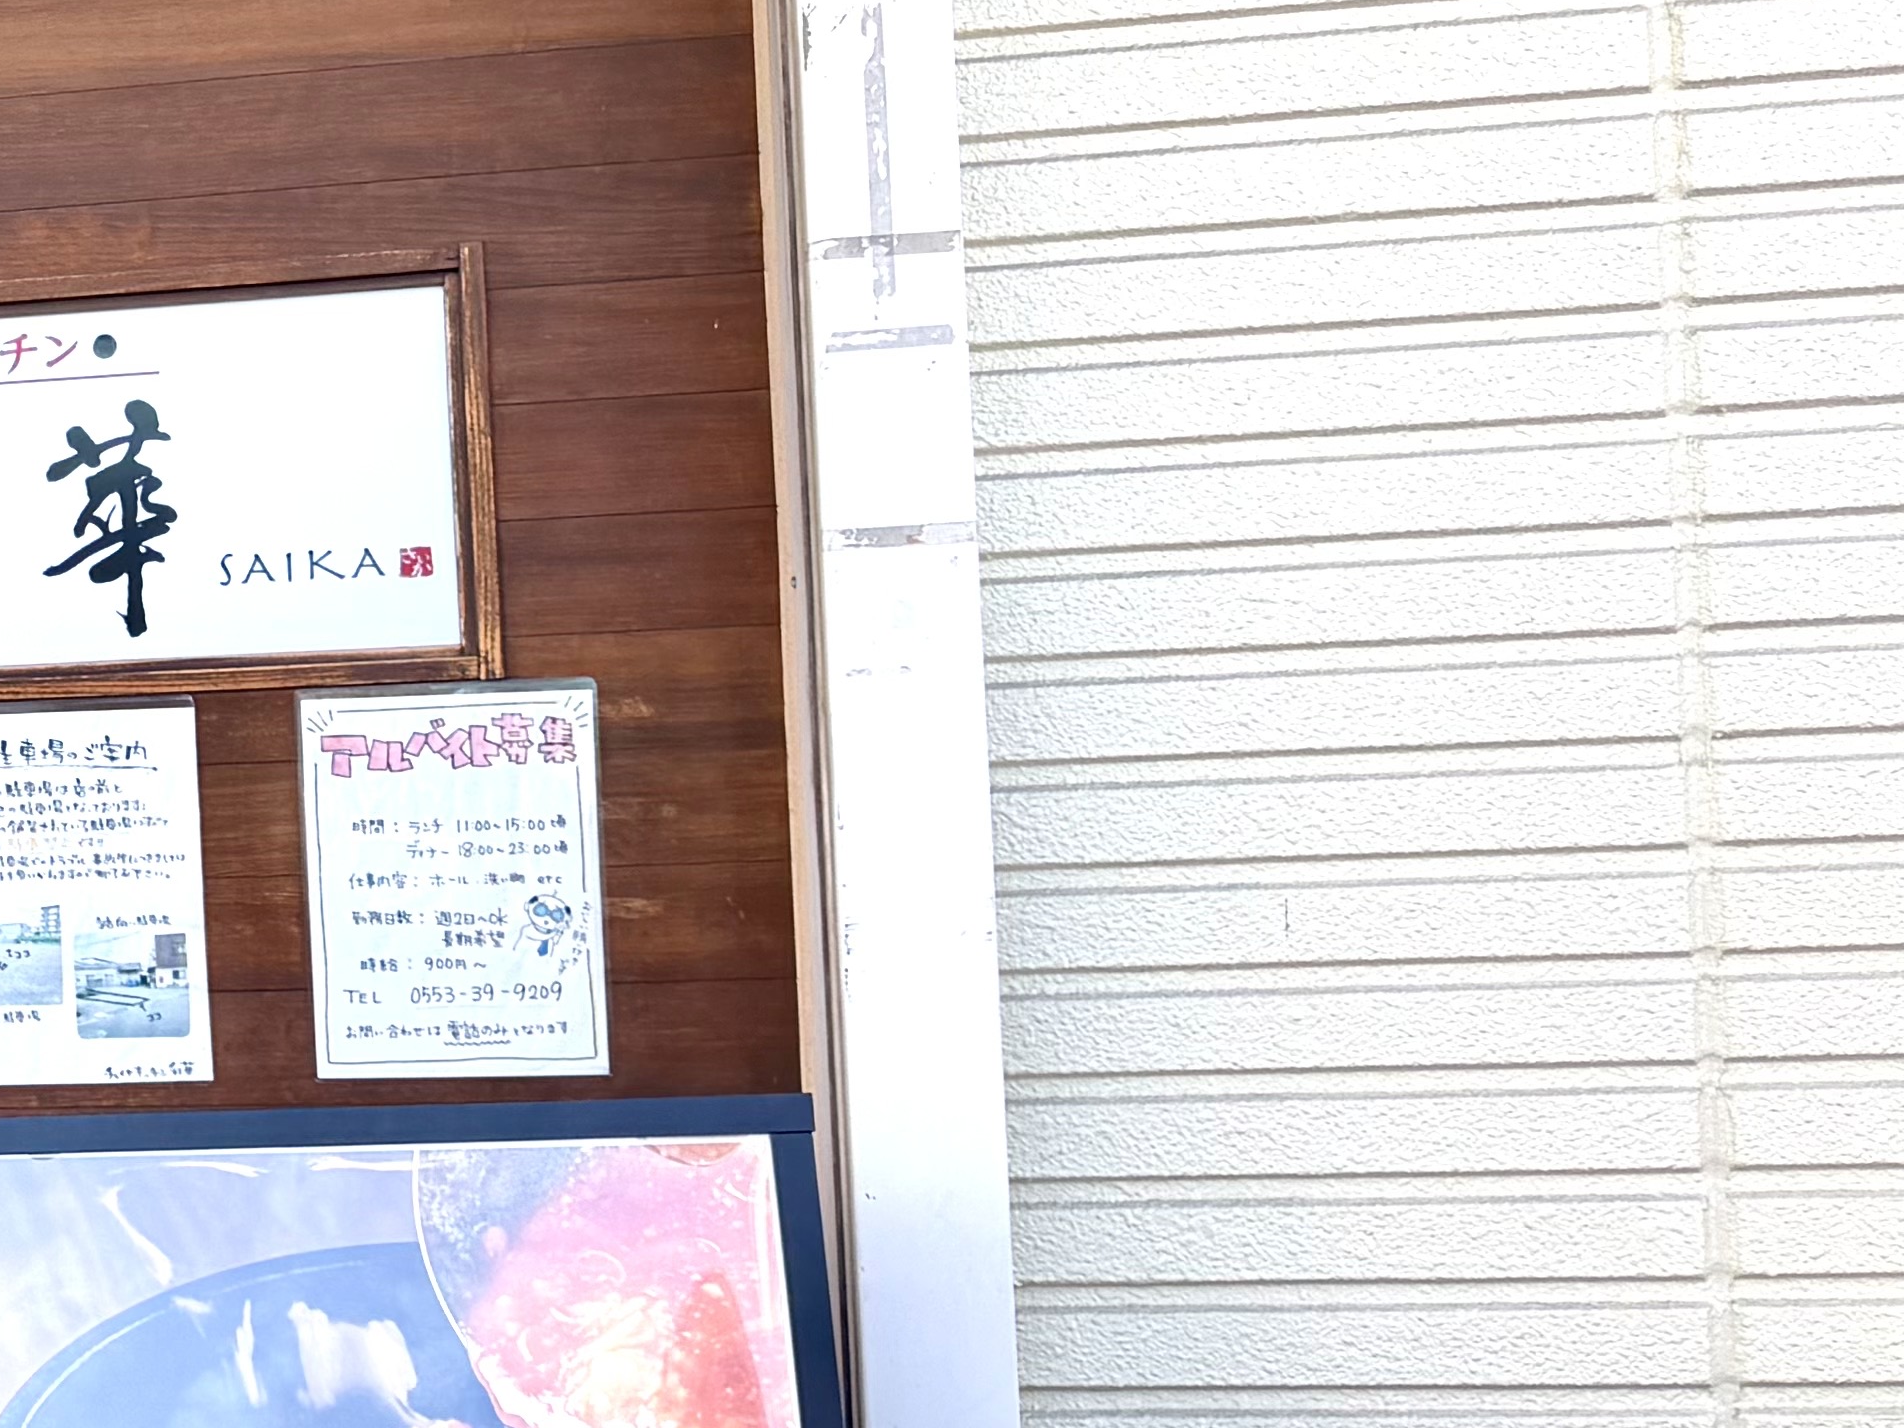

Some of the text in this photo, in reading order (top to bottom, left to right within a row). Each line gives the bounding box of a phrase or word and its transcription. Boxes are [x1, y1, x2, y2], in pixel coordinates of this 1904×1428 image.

[219, 547, 386, 587] SAIKA
[320, 713, 577, 778] アルバイト募集
[408, 820, 443, 834] ランチ
[406, 839, 449, 859] ディナー
[343, 981, 563, 1005] TEL 0553-39-9209
